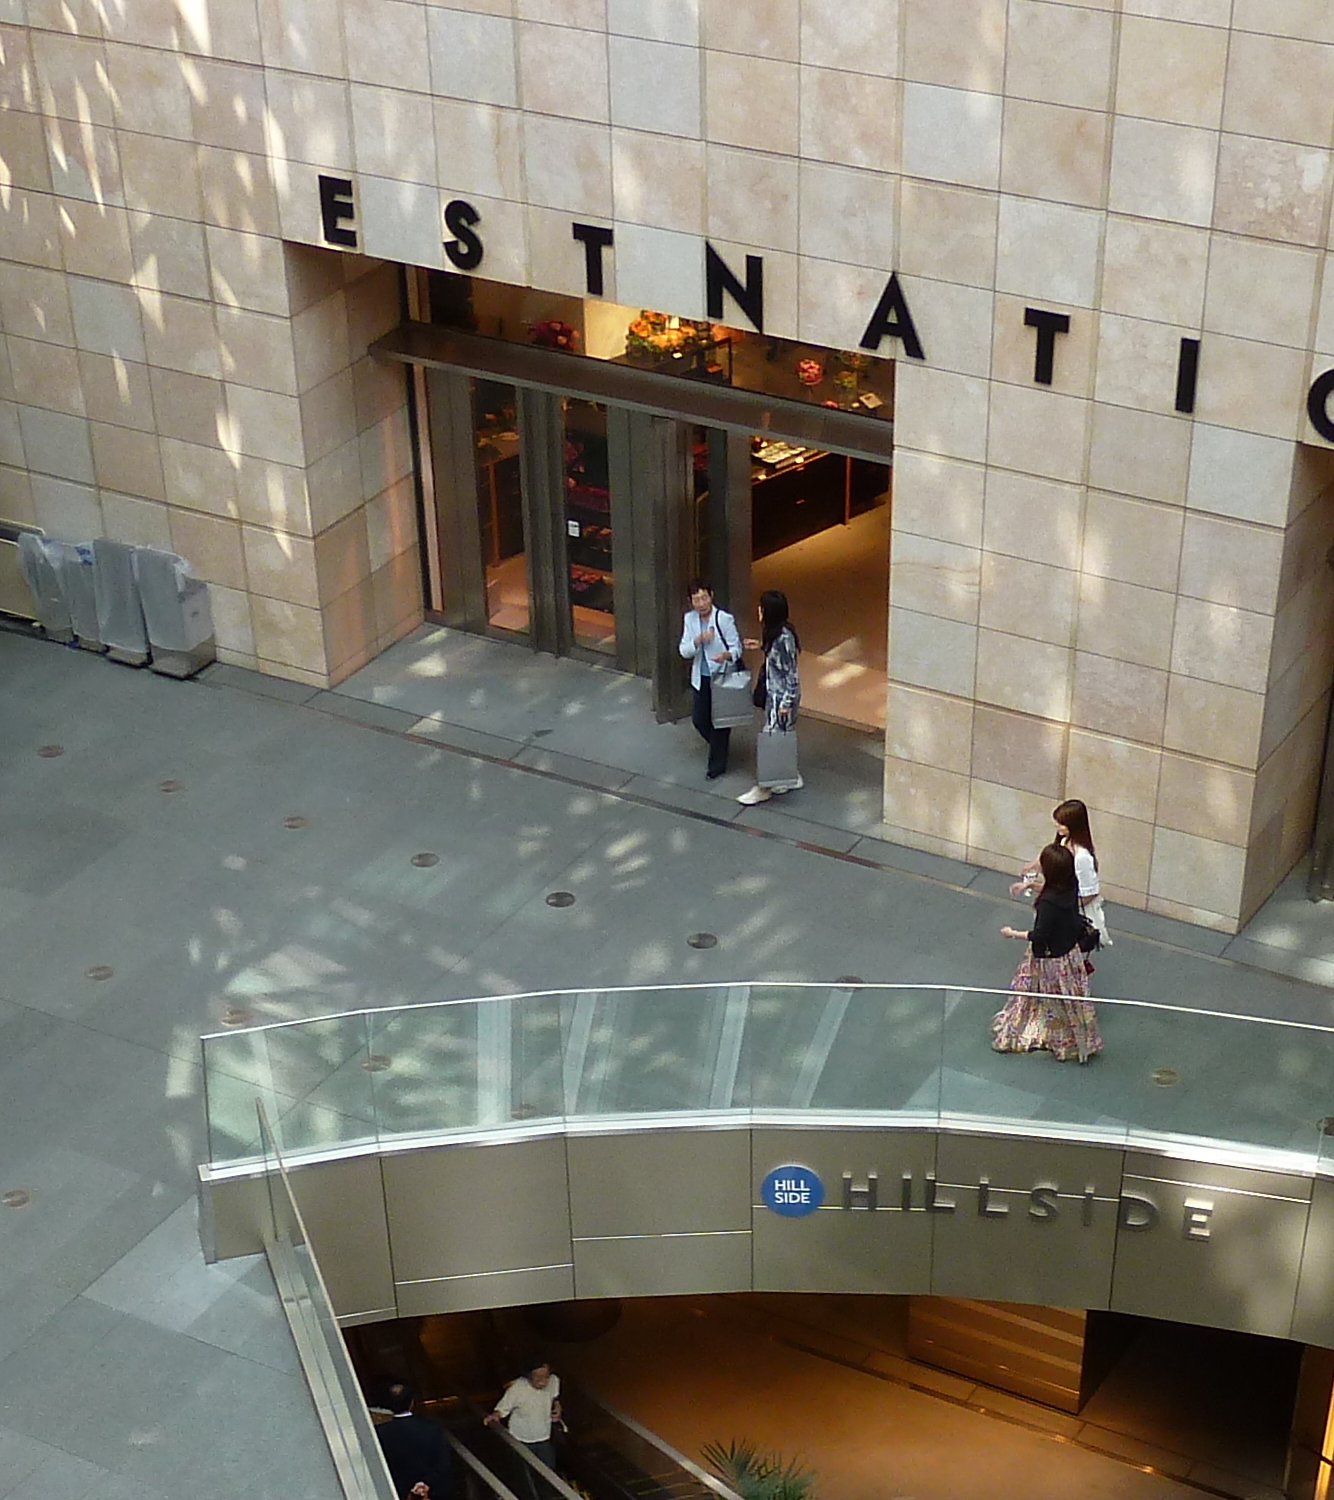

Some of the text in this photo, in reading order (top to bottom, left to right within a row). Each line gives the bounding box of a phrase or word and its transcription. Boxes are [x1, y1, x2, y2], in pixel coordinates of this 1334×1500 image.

[774, 1179, 811, 1191] HILL
[774, 1191, 811, 1204] SIDE
[841, 1170, 1215, 1243] HILLSIDE
